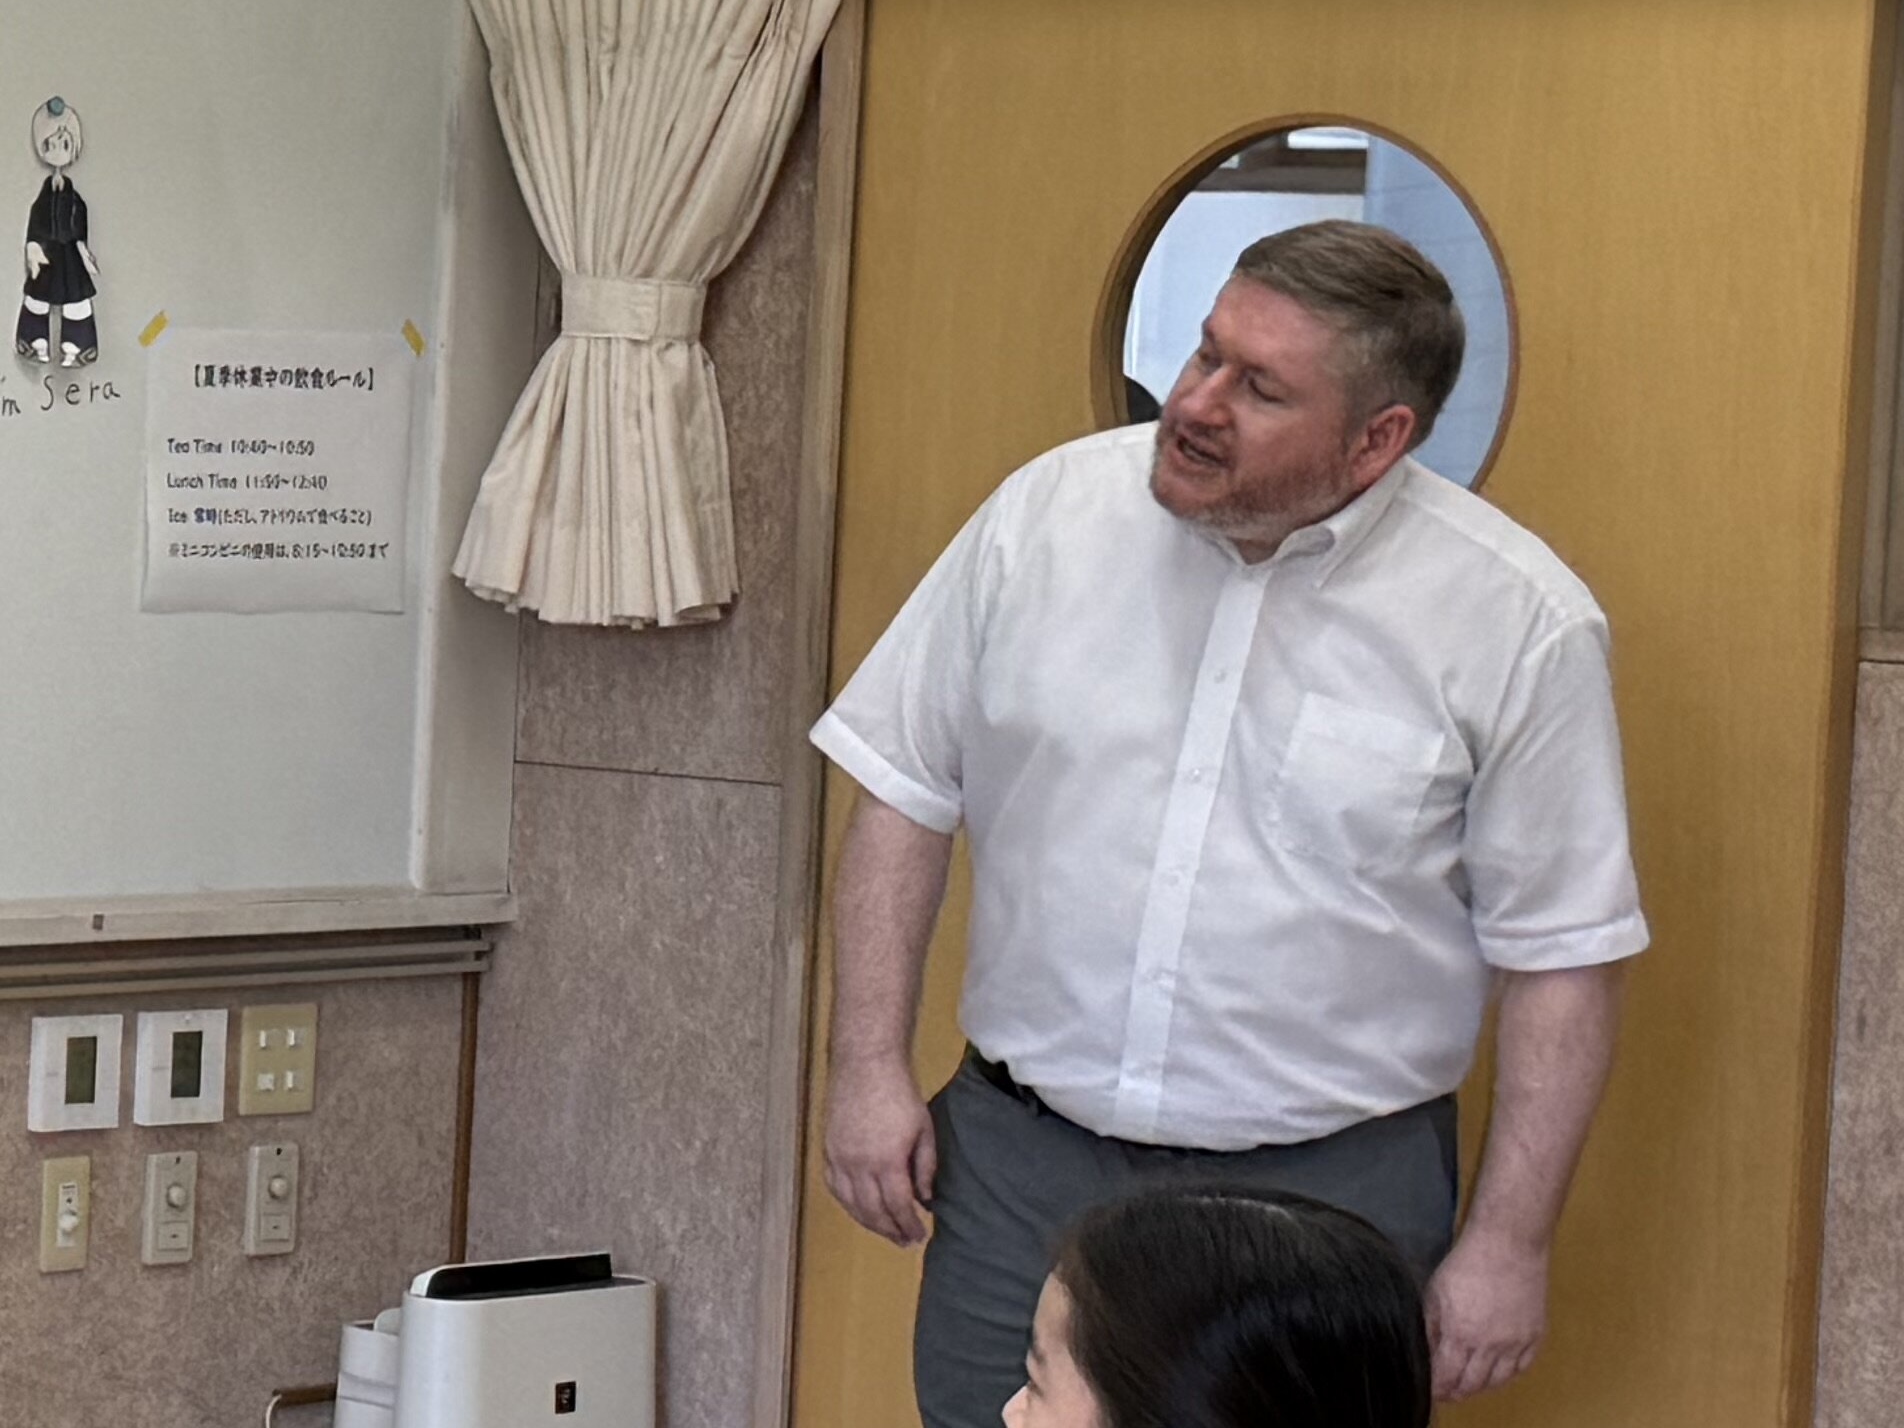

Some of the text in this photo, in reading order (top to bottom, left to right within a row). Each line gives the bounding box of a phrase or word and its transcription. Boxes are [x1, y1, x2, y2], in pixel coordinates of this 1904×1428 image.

[40, 375, 121, 411] Sera
[167, 438, 190, 454] Tea
[167, 473, 204, 489] Lunch
